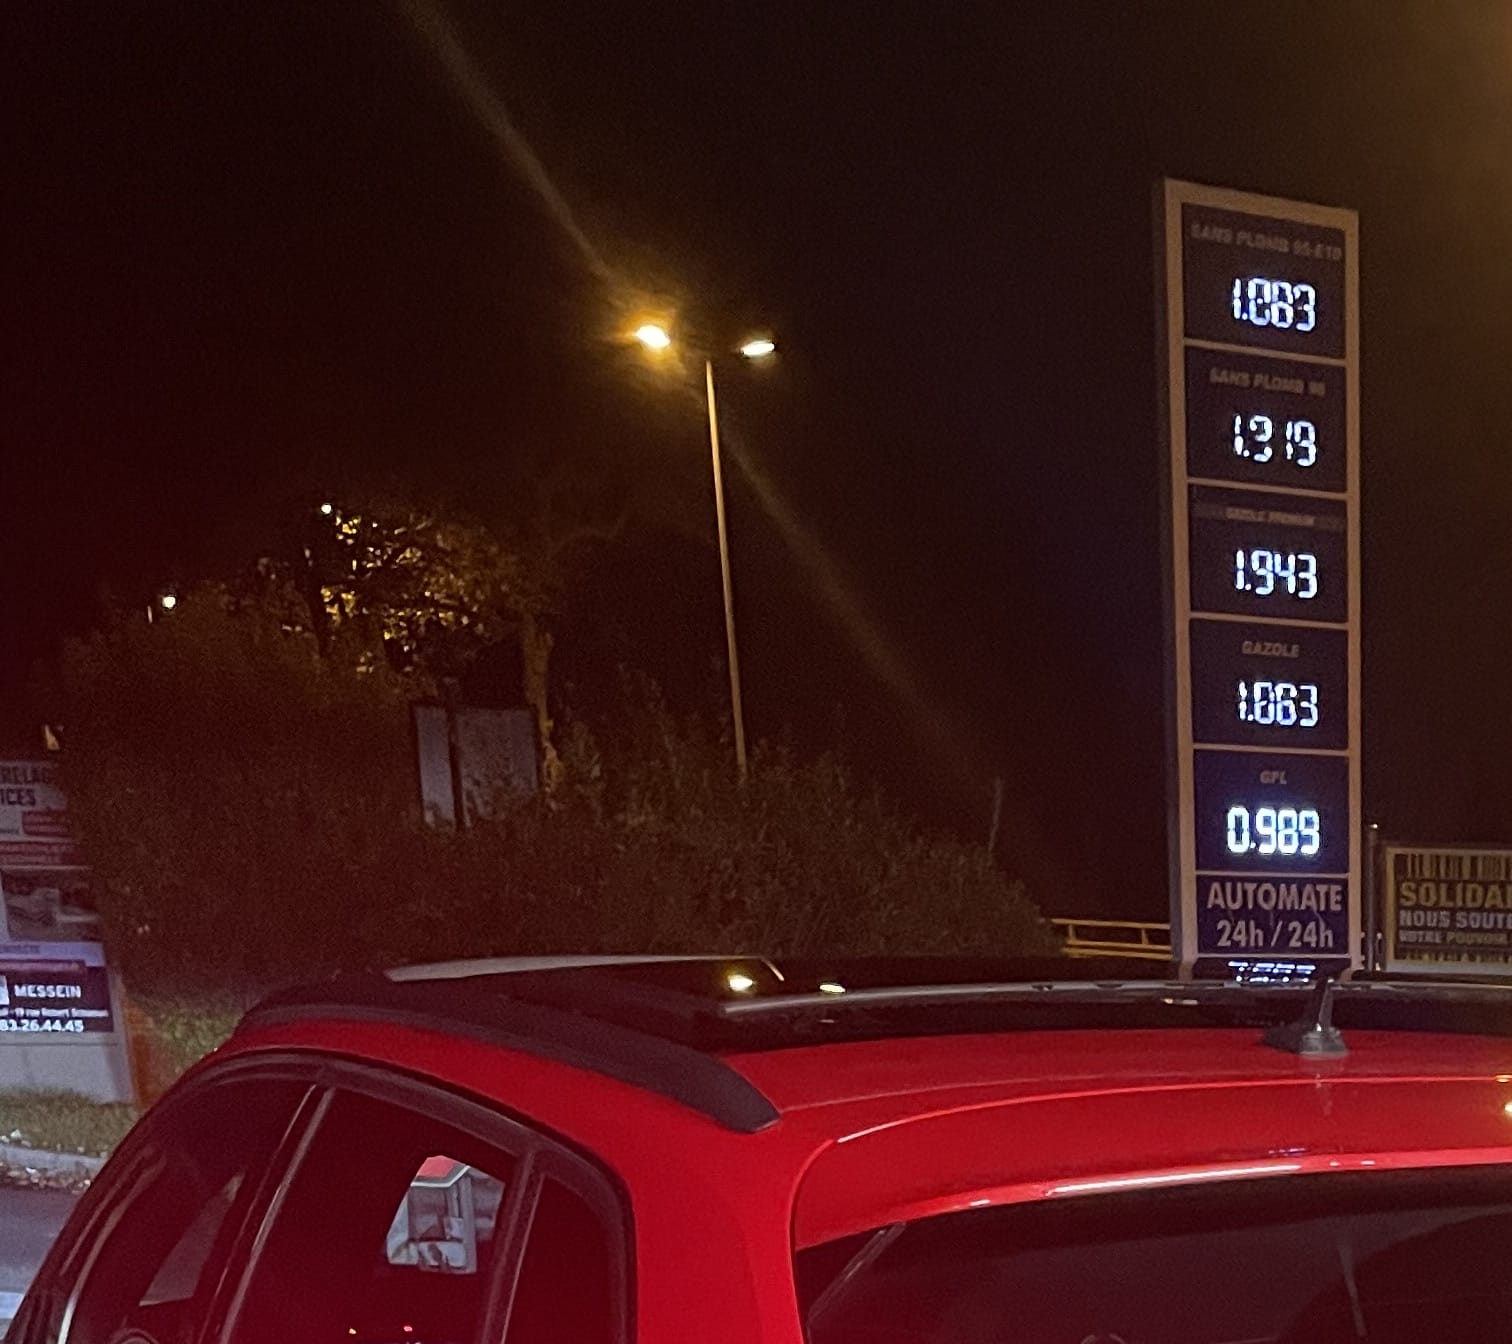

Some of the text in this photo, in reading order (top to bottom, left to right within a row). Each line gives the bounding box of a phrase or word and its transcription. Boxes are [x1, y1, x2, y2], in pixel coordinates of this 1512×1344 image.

[1236, 550, 1318, 599] 1.943
[1242, 640, 1299, 658] GAZOLE
[1260, 770, 1287, 785] GPL
[1227, 806, 1320, 856] 0.989
[1207, 882, 1343, 913] AUTOMATE
[1400, 910, 1449, 928] NOUS
[1217, 919, 1264, 948] 24h
[1288, 921, 1333, 949] 24h
[14, 984, 82, 999] MESSEIN
